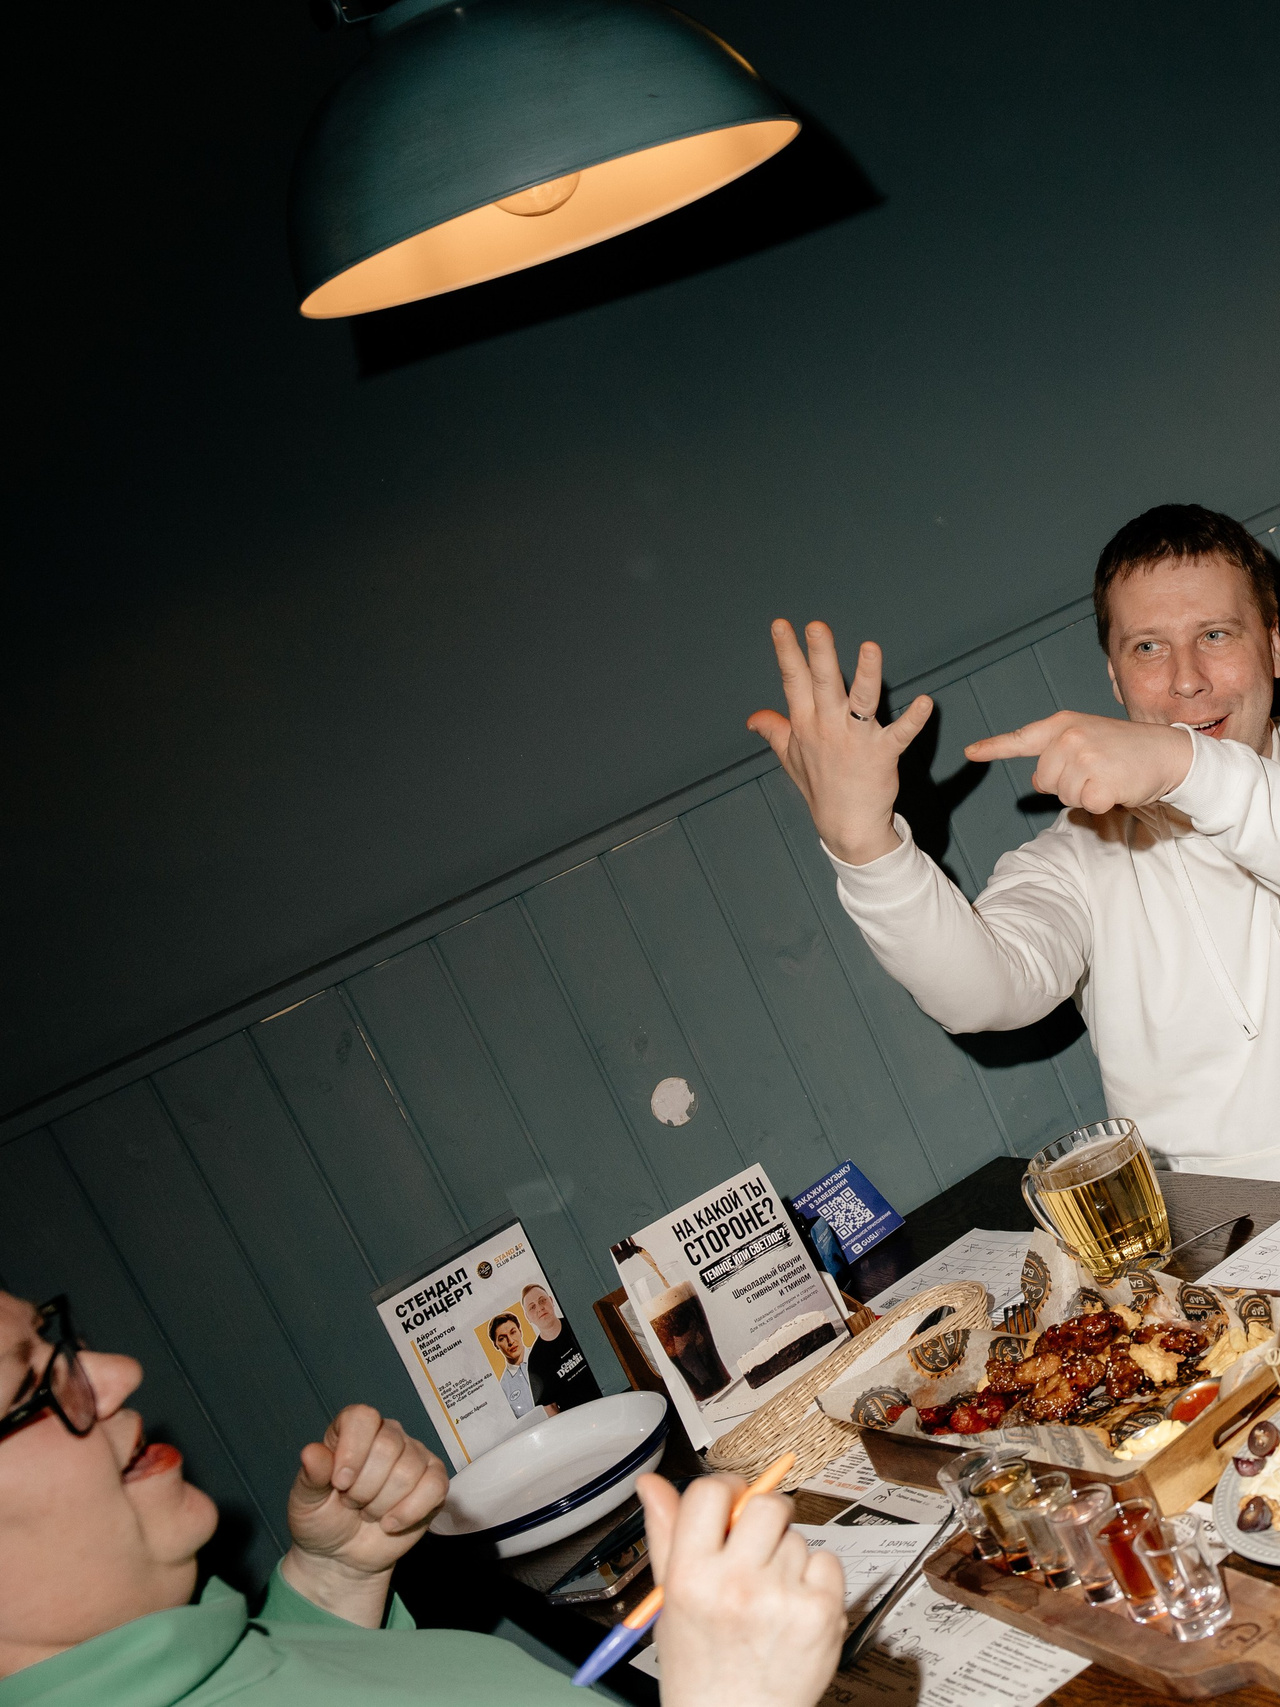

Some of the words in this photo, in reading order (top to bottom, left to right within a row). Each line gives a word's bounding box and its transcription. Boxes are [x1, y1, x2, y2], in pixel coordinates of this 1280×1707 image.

[793, 1185, 824, 1210] ЗАКАЖИ
[822, 1163, 851, 1188] МУЗЫКУ
[814, 1178, 849, 1206] ЗАВЕДЕНИИ
[672, 1219, 696, 1242] НА
[694, 1188, 743, 1229] КАКОЙ
[740, 1177, 766, 1201] ТЫ
[684, 1198, 775, 1265] СТОРОНЕ?
[494, 1248, 515, 1263] STAND
[496, 1258, 509, 1268] CLUB
[510, 1249, 525, 1260] KAZAN
[702, 1258, 735, 1282] ТЕМНОЕ
[732, 1249, 751, 1266] ИЛИ
[749, 1228, 785, 1255] СВЕТЛОЕ?
[732, 1267, 778, 1299] Шоколадный
[777, 1254, 802, 1272] брауни
[751, 1280, 780, 1300] пивным
[779, 1264, 806, 1283] кремом
[784, 1273, 811, 1292] тмином
[1023, 1265, 1034, 1277] БА
[1129, 1279, 1144, 1287] БА
[396, 1268, 467, 1317] СТЕНДАП
[1188, 1295, 1205, 1303] БАР
[402, 1282, 472, 1333] КОНЦЕРТ
[1251, 1305, 1265, 1315] БАР
[416, 1328, 437, 1344] Айрат
[419, 1326, 455, 1350] Мавлютов
[945, 1331, 955, 1346] БА
[422, 1344, 441, 1357] Влад
[426, 1340, 462, 1364] Хандешин
